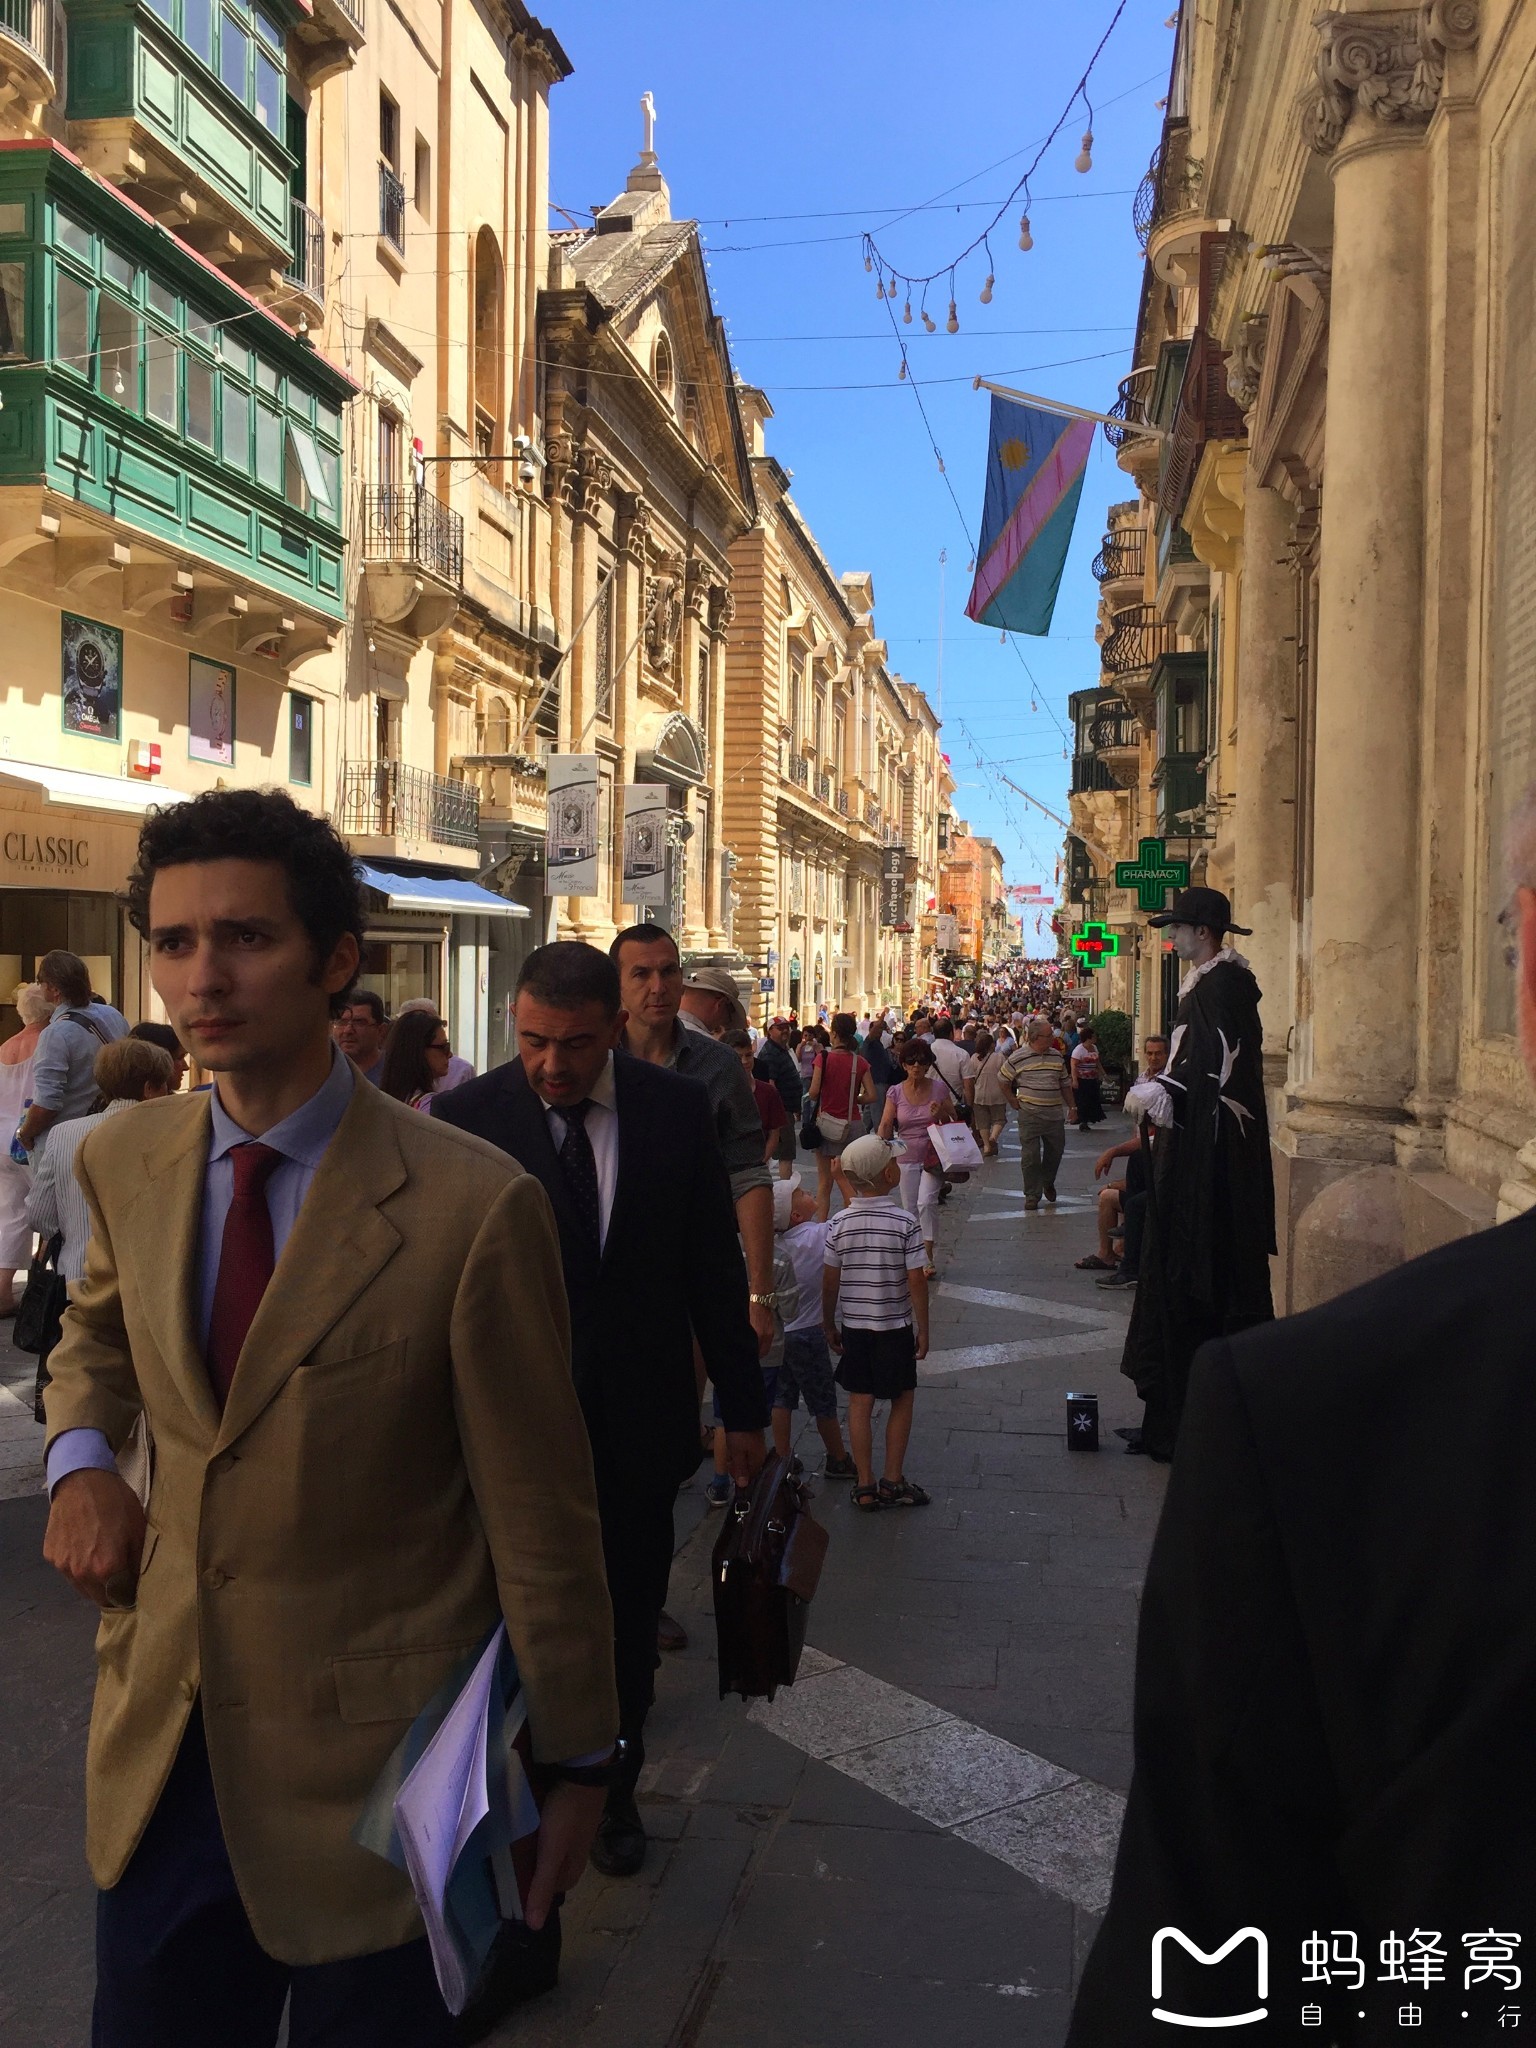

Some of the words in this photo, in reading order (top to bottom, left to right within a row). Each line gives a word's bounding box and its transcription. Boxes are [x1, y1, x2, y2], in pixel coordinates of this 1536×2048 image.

[81, 713, 100, 724] OMEGA
[4, 832, 89, 868] CLASSIC
[1123, 870, 1180, 879] PHARMACY
[884, 852, 904, 925] Archaeology
